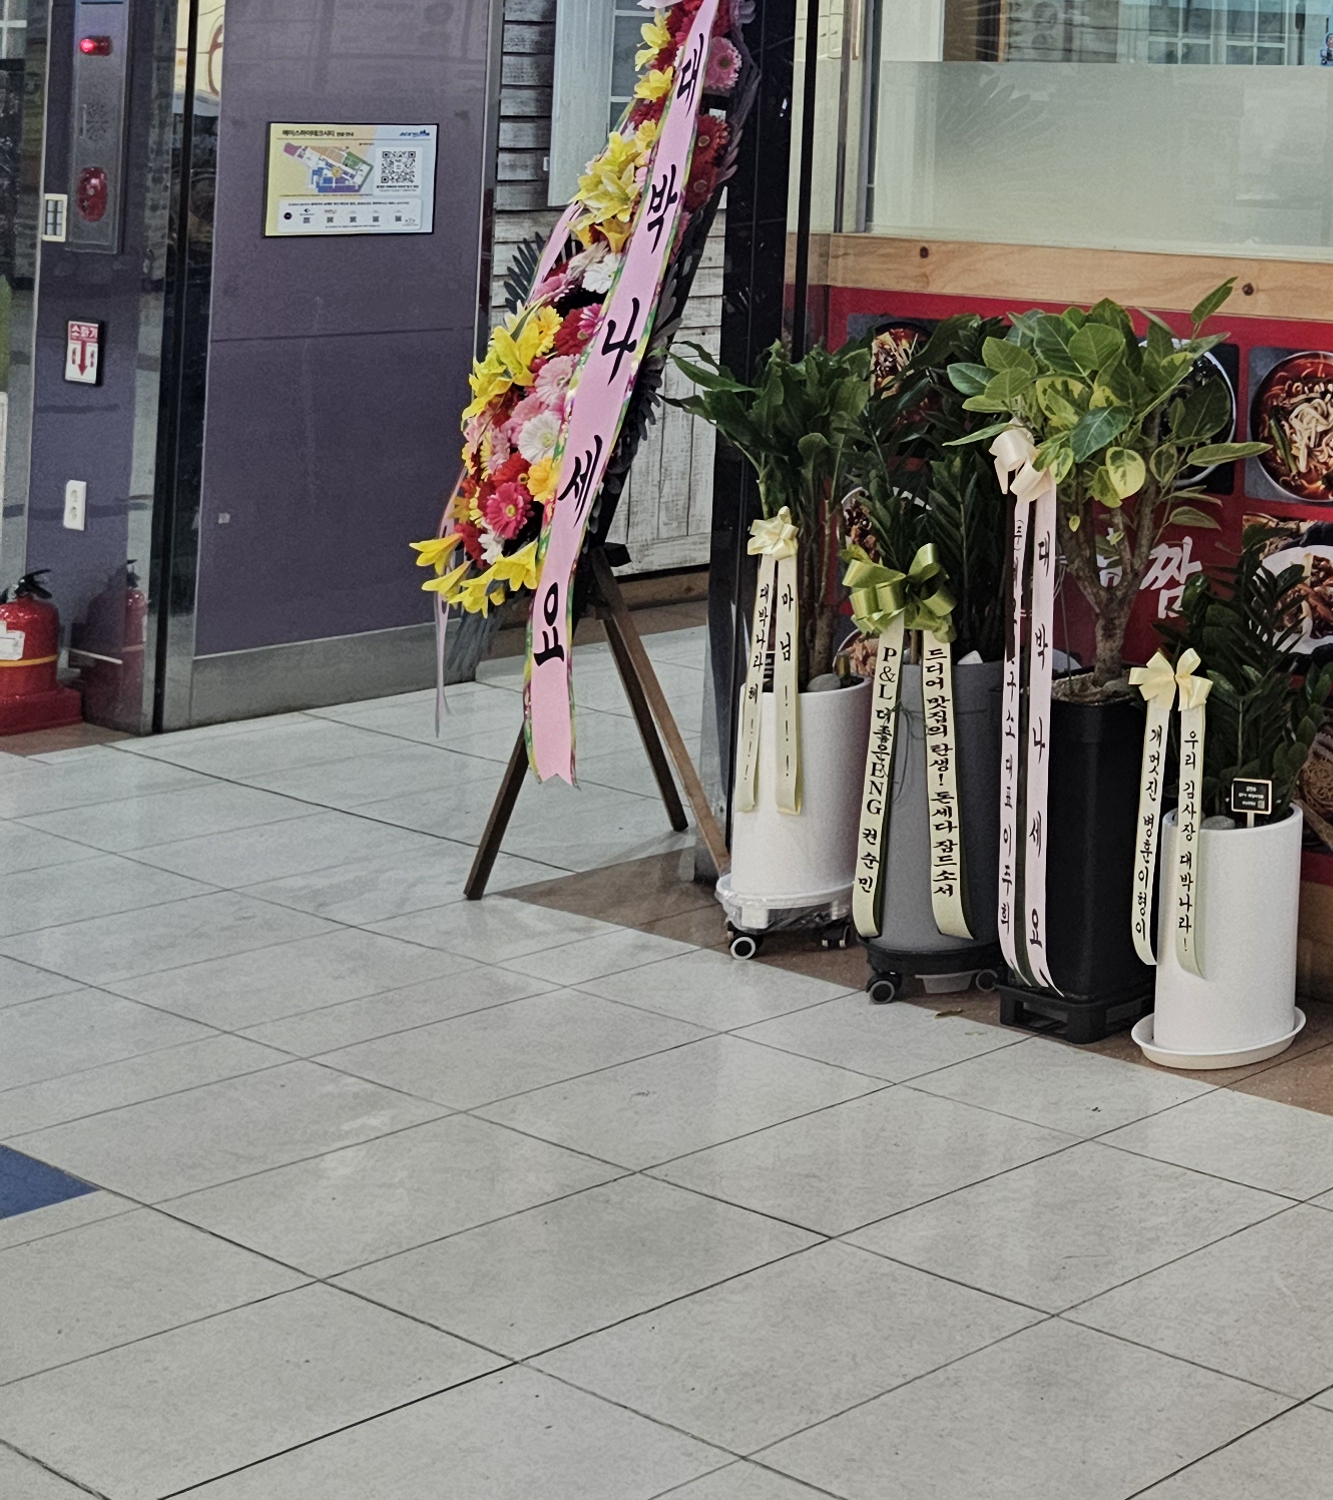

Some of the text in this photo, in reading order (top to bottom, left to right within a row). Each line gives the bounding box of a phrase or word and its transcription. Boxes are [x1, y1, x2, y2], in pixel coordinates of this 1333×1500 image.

[71, 324, 98, 339] 소화기
[879, 647, 897, 700] P&L
[925, 648, 948, 690] 드디어
[926, 695, 951, 737] 맛집의
[1146, 725, 1162, 802] 개멋진
[1184, 731, 1199, 770] 우리
[931, 791, 958, 834] 돈세다
[1181, 780, 1197, 841] 김사장
[933, 839, 958, 897] 잠드소서
